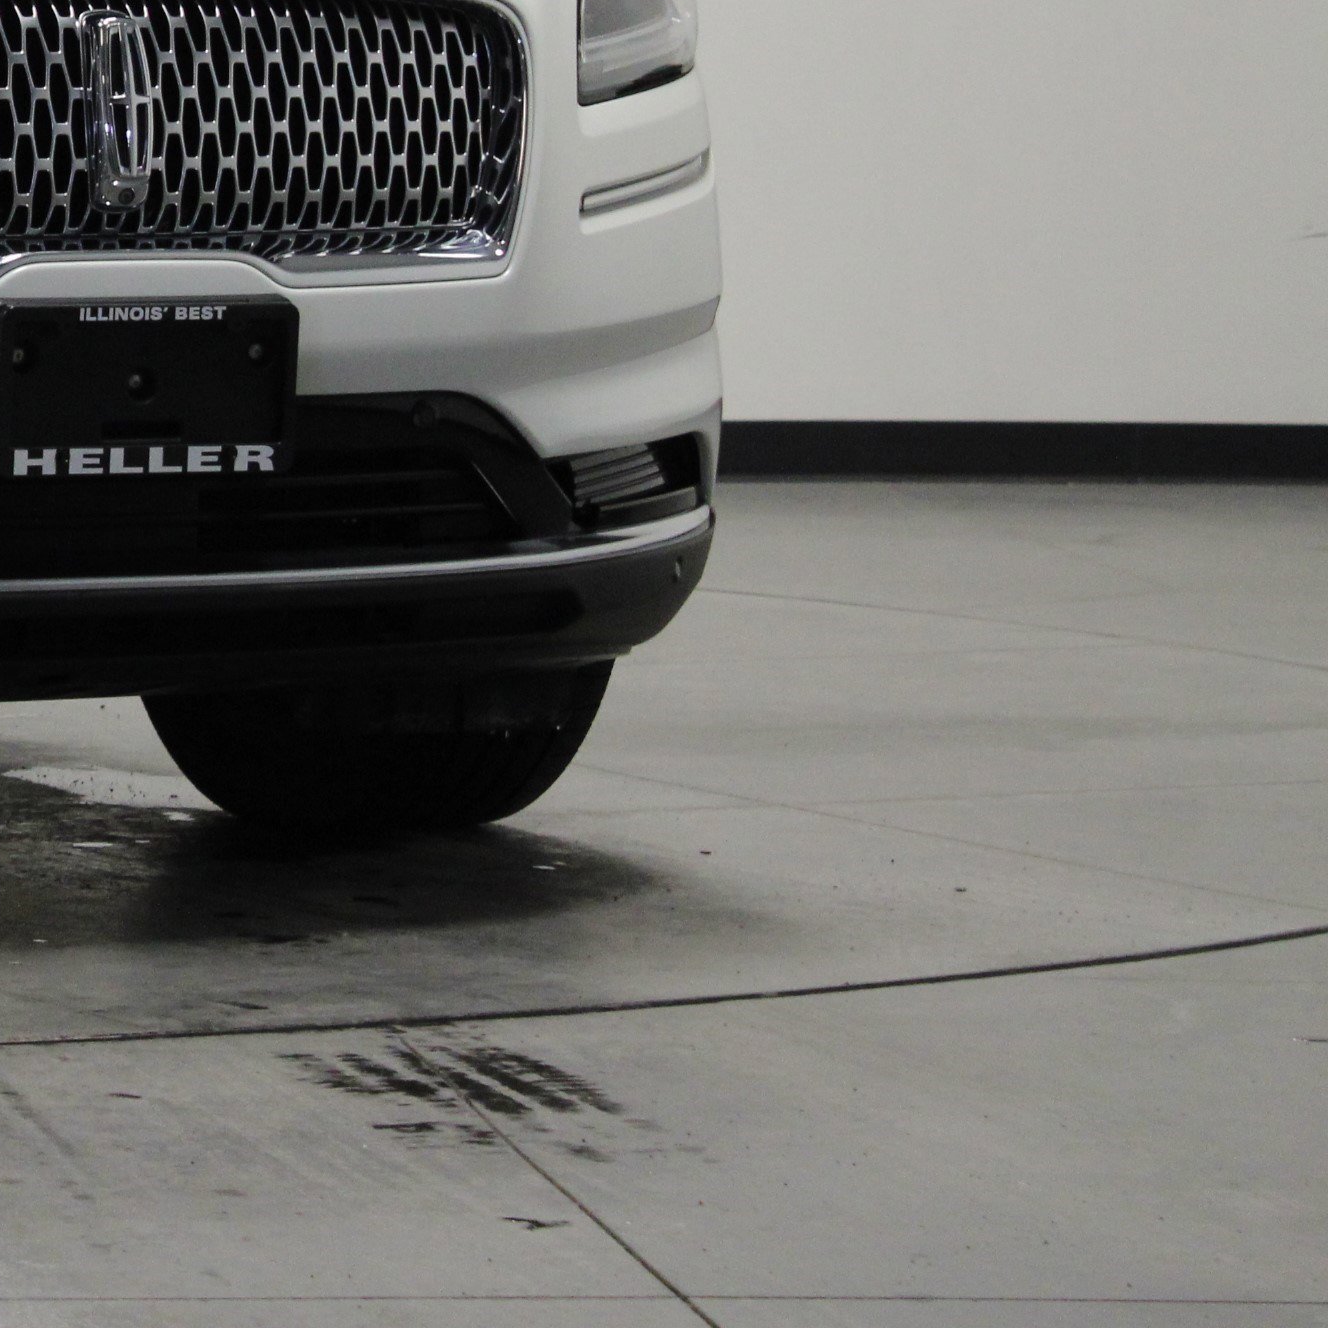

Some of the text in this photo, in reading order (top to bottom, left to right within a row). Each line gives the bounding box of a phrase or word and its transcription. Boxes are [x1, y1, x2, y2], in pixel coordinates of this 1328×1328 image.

[79, 306, 227, 322] ILLINOIS' BEST
[13, 445, 275, 476] HELLER
